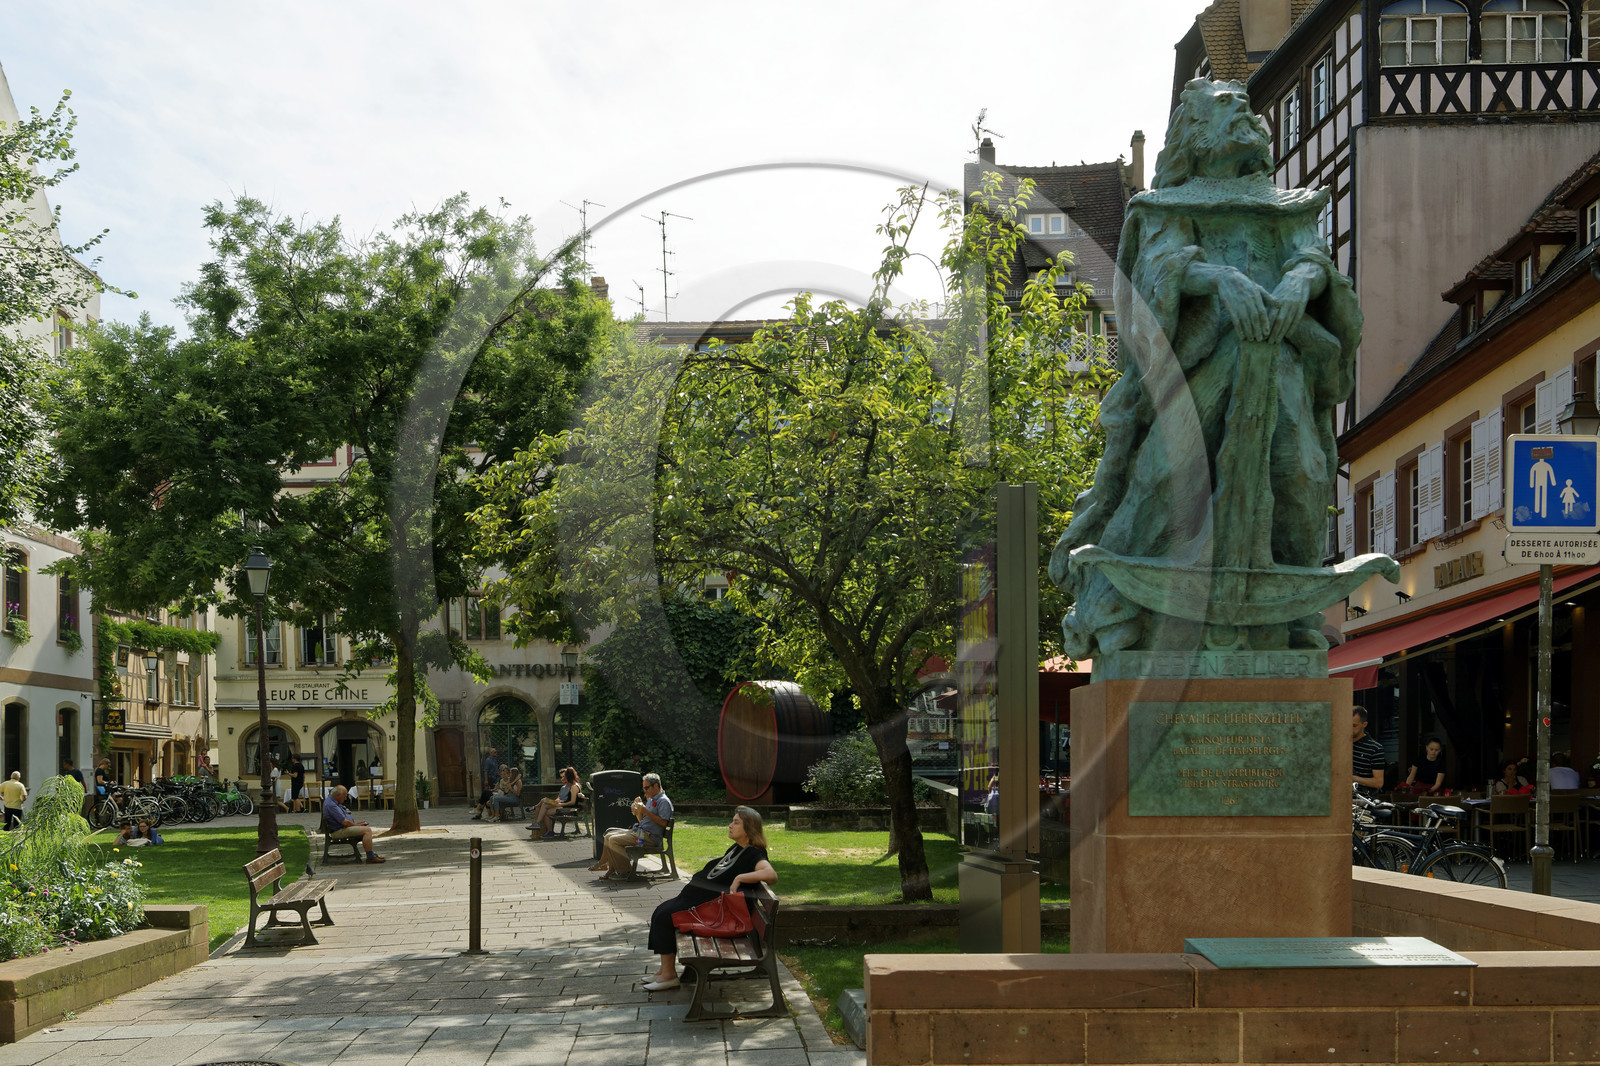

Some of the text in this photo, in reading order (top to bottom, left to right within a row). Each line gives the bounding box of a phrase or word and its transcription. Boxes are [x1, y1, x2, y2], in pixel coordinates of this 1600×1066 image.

[1510, 539, 1598, 549] DESSERTE AUTORISÉE
[1521, 550, 1532, 559] DE
[1556, 549, 1562, 559] À
[302, 689, 320, 701] DE
[324, 688, 369, 701] CHINE
[1155, 712, 1304, 725] CHEVALIER LIEBENZELLER
[1246, 735, 1258, 745] DE
[1200, 768, 1213, 778] DE
[1215, 768, 1227, 778] LA
